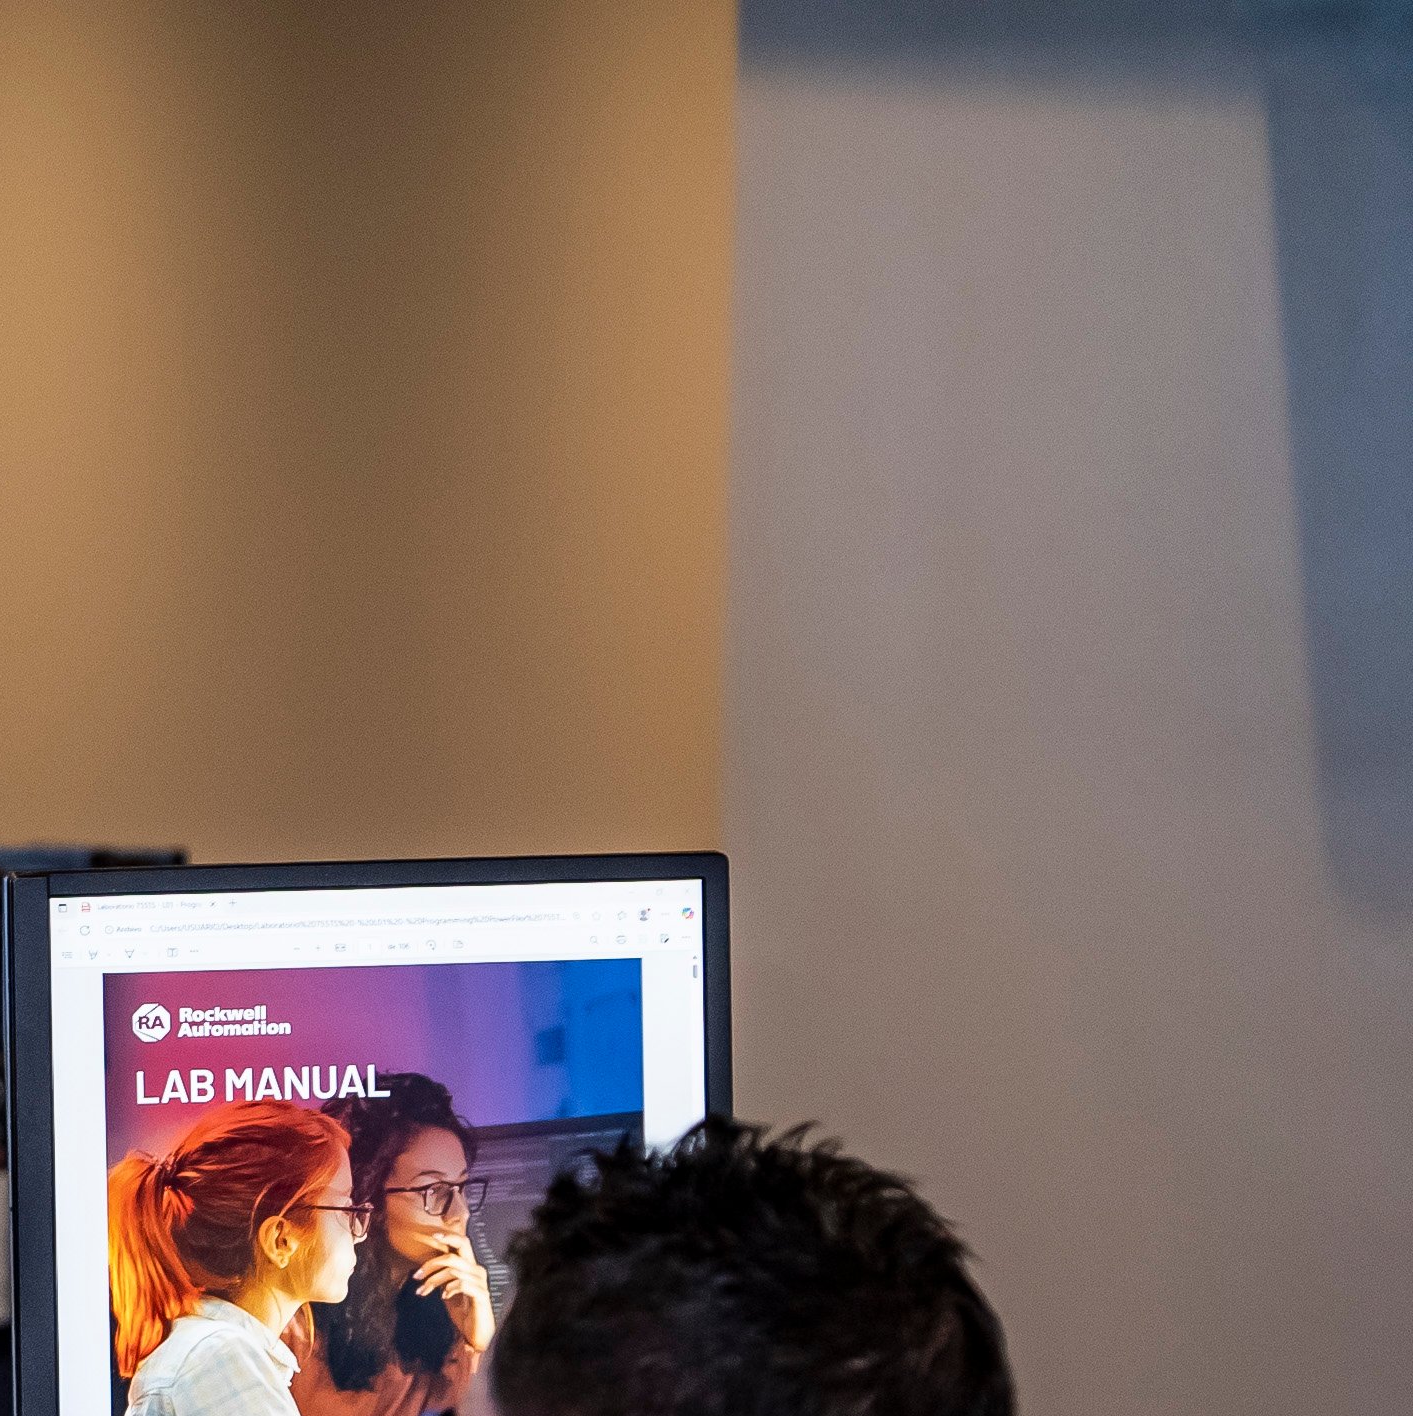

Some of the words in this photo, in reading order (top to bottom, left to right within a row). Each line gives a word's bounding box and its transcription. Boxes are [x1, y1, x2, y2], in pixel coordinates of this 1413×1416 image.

[138, 1015, 165, 1030] RA
[178, 1004, 267, 1023] Rockwell
[177, 1020, 292, 1039] Automation
[136, 1068, 215, 1105] LAB
[225, 1064, 391, 1102] MANUAL
